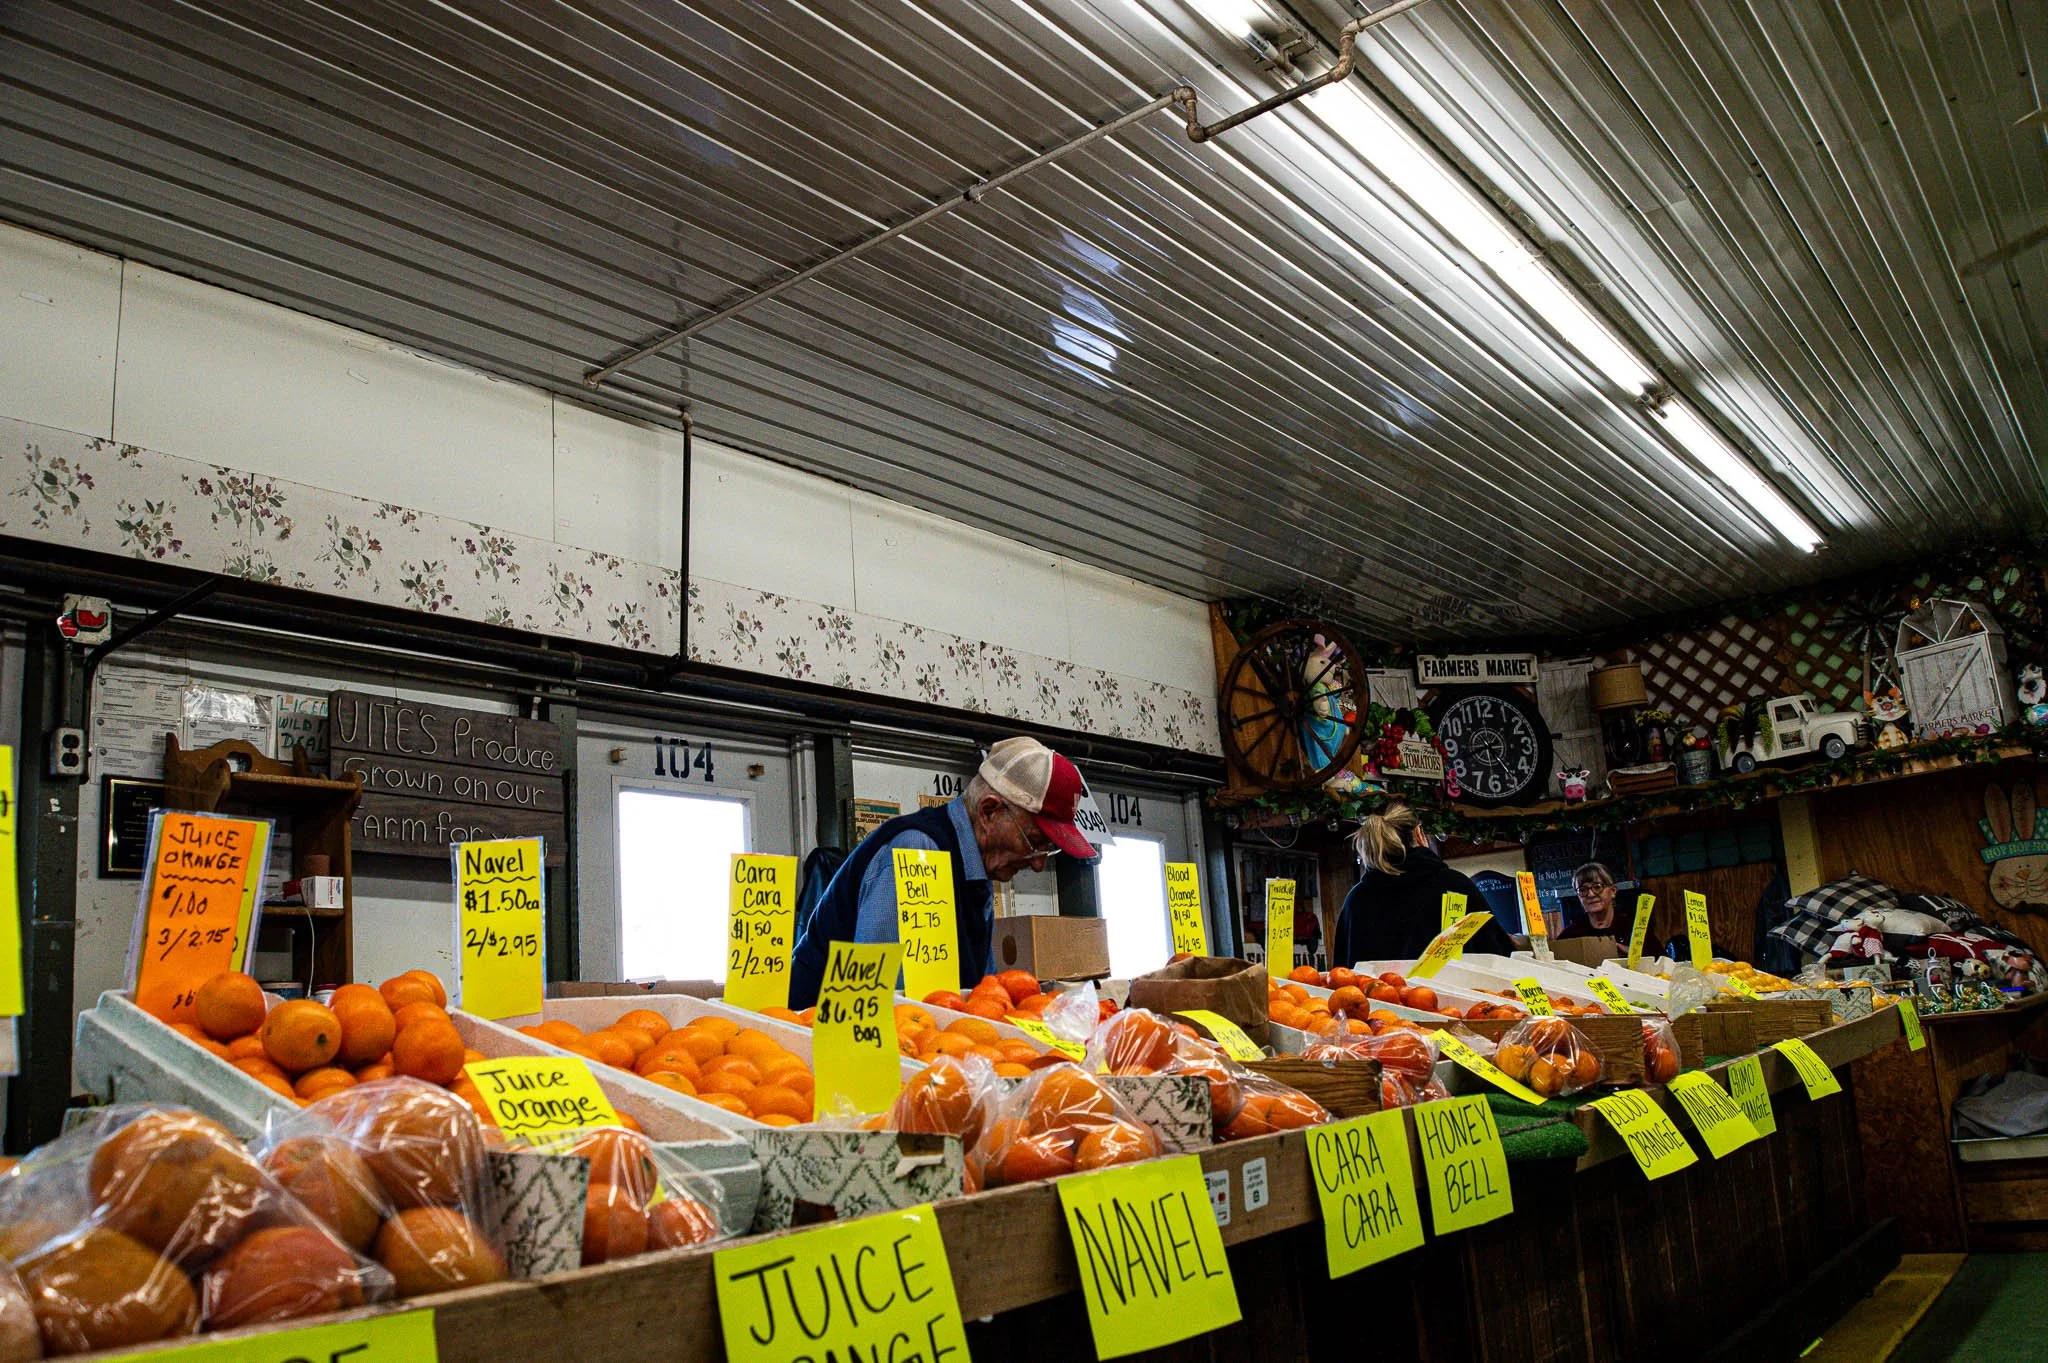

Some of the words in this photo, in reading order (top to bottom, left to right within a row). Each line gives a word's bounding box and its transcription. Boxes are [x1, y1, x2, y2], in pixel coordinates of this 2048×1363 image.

[1423, 659, 1479, 677] FARMERS
[1486, 659, 1532, 677] MARKET
[1474, 700, 1494, 718] 12
[1960, 707, 1996, 723] MARKET
[1446, 716, 1462, 737] 10
[1511, 716, 1525, 735] 2
[454, 717, 554, 771] Produce
[1444, 738, 1458, 758] 9
[1520, 736, 1532, 755] 3
[654, 735, 714, 783] 104
[1404, 752, 1441, 770] TOMATOES
[1453, 758, 1467, 778] 8
[1517, 755, 1530, 774] 4
[343, 757, 443, 795] Grown
[454, 776, 488, 801] on
[496, 780, 545, 806] our
[933, 773, 965, 797] 104
[1471, 771, 1484, 790] 7
[1488, 774, 1501, 793] 6
[1109, 792, 1142, 826] 104
[169, 821, 240, 850] JUICE
[435, 811, 483, 844] for
[164, 850, 243, 870] ORANGE
[465, 847, 524, 876] Navel
[735, 858, 776, 885] Cara
[897, 853, 937, 880] Honey
[1167, 865, 1190, 882] Blood
[743, 888, 781, 908] Cara
[905, 881, 929, 899] Bell
[1169, 886, 1197, 905] Orange
[902, 910, 941, 929] $1.75
[158, 926, 232, 962] 3/2.75
[905, 938, 949, 964] 2/3.25
[731, 947, 784, 979] 2/2.95
[829, 949, 886, 984] Navel
[817, 996, 879, 1024] $6.95
[853, 1025, 882, 1048] Bag
[476, 1069, 569, 1094] Juice
[1730, 1063, 1755, 1098] SUMO
[498, 1096, 598, 1126] Orange
[1599, 1093, 1649, 1129] BLOOD
[1420, 1100, 1493, 1160] HONEY
[1626, 1118, 1685, 1168] ORANGE
[1315, 1125, 1386, 1193] CARA
[1444, 1157, 1499, 1214] BELL
[1342, 1181, 1404, 1250] CARA
[1073, 1190, 1224, 1316] NAVEL
[729, 1233, 934, 1346] JUICE
